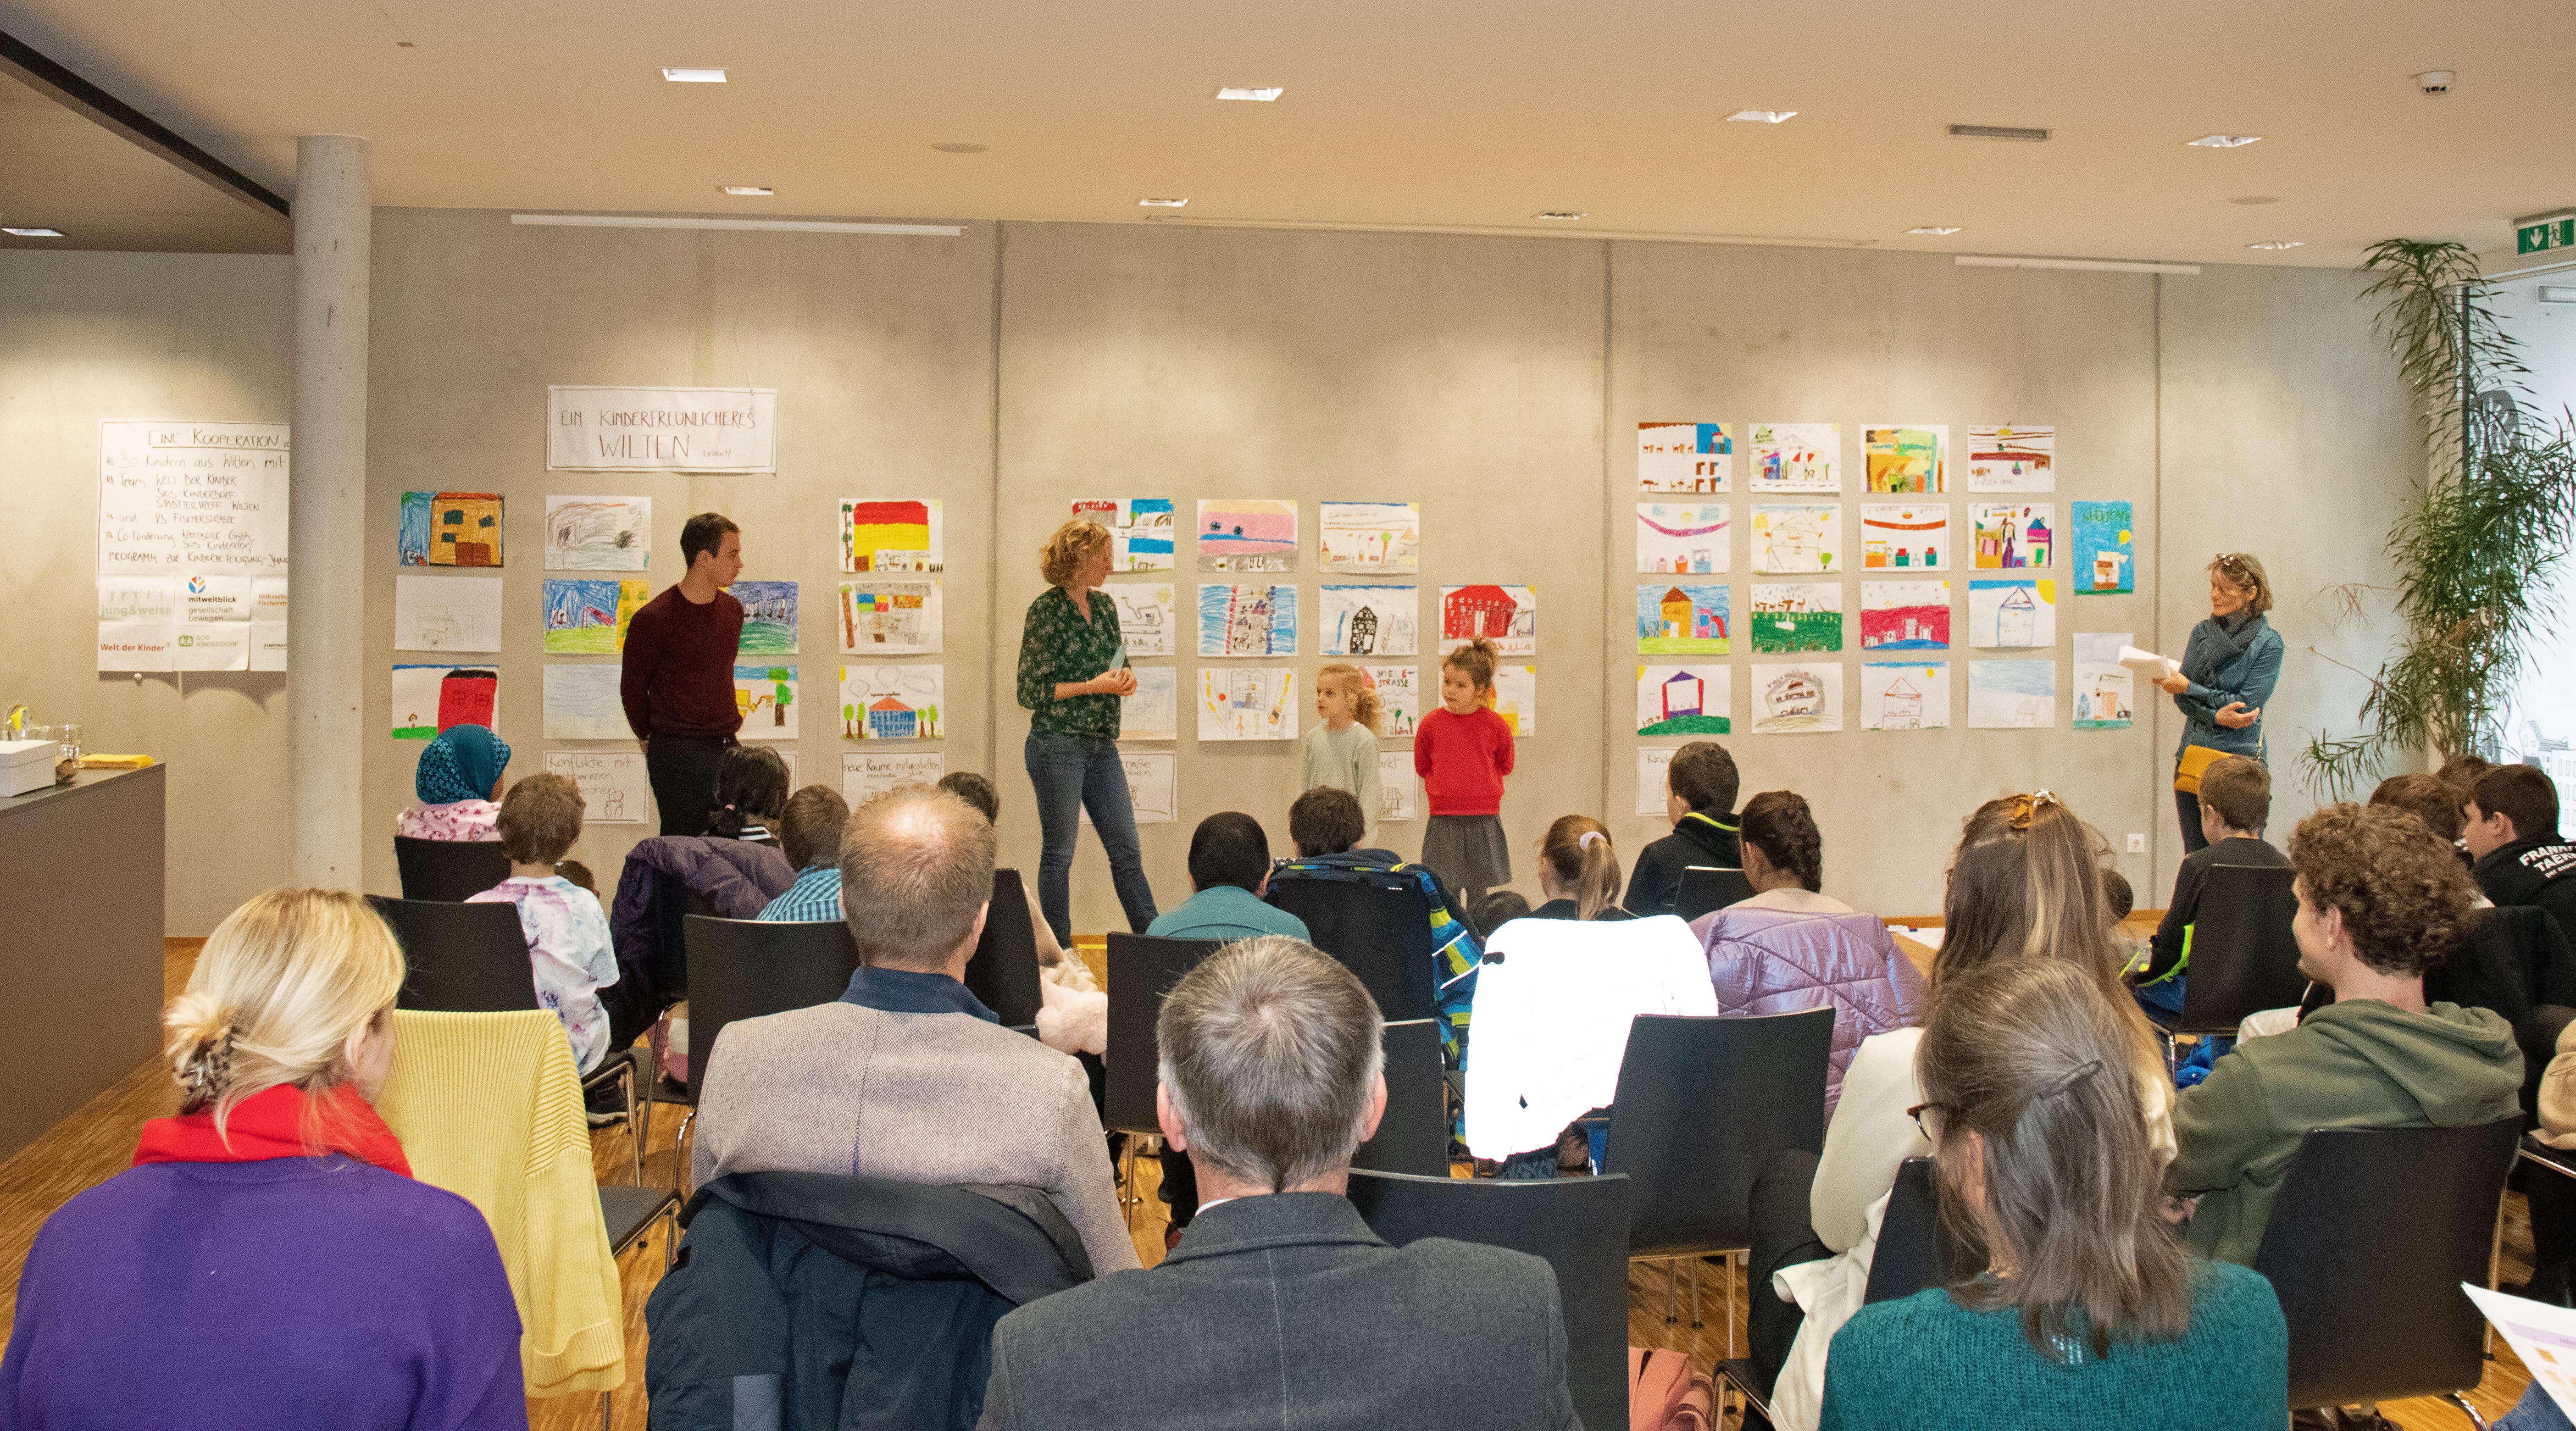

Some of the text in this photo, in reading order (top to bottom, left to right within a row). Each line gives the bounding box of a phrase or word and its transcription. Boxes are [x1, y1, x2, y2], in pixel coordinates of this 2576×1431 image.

[561, 410, 583, 427] EIN
[148, 430, 180, 445] EINE
[193, 428, 279, 447] KOOPERATION
[599, 434, 689, 459] WILTEN
[146, 455, 186, 467] Kindern
[194, 458, 214, 467] aus
[223, 454, 255, 468] Wilten
[265, 455, 286, 468] mit
[120, 473, 237, 487] Team WELT DER KINDER
[232, 501, 260, 510] WILTEN
[119, 513, 138, 523] und
[155, 513, 168, 525] VS
[109, 551, 158, 564] PROGRAMM
[189, 606, 233, 615] gesellschaft
[1378, 678, 1409, 688] STRASSE
[550, 754, 635, 775] Konflikte mit
[844, 763, 863, 772] neue
